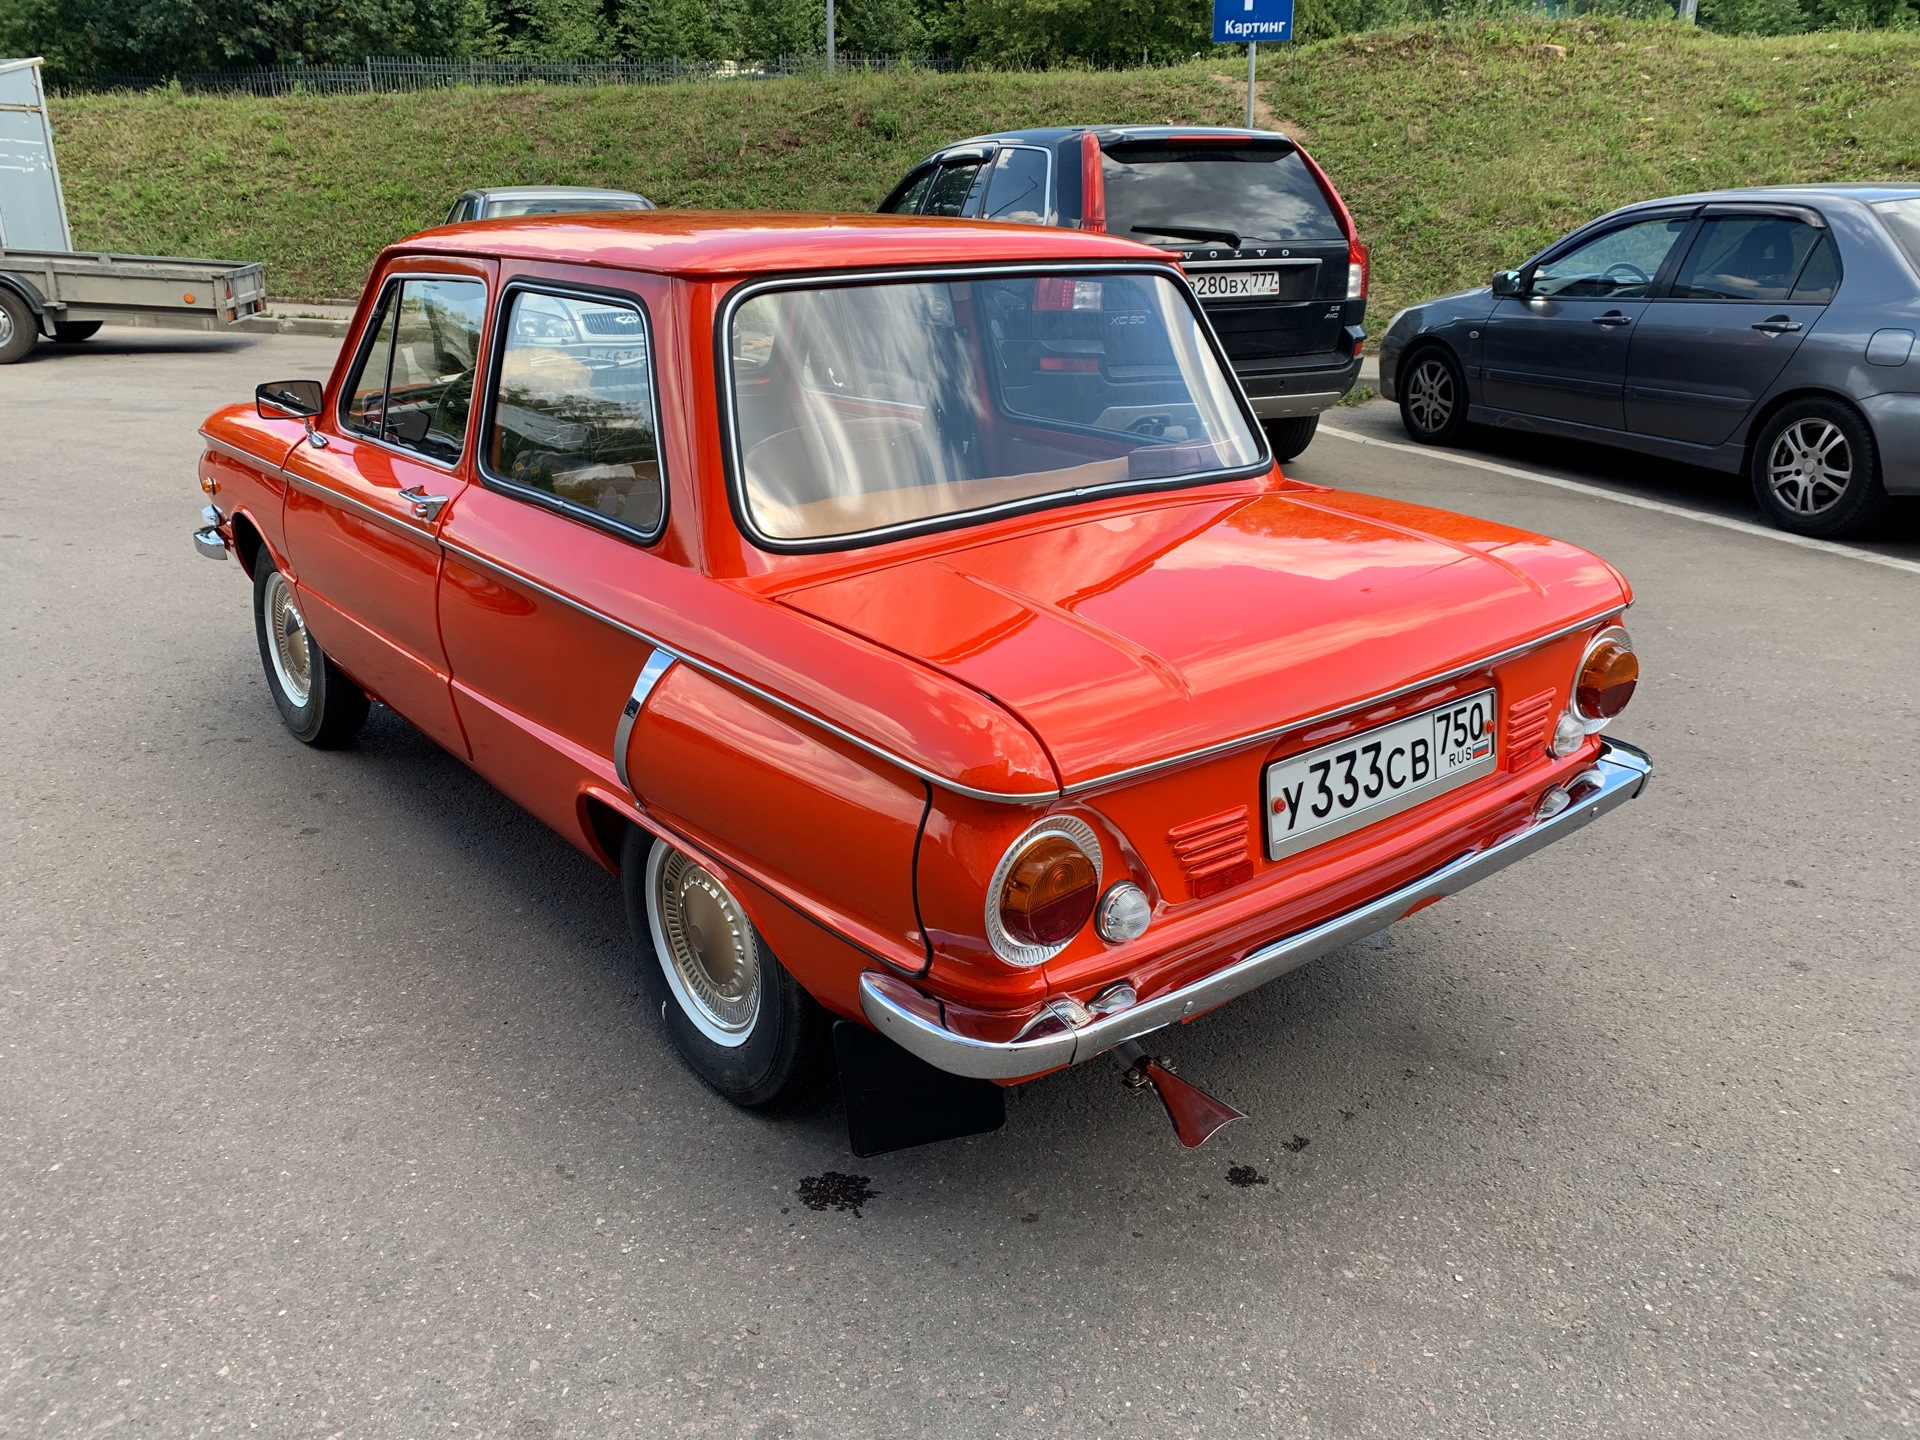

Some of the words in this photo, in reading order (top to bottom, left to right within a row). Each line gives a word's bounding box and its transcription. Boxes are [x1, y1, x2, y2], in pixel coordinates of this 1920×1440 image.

[1225, 20, 1286, 37] Картинг
[1183, 249, 1290, 260] VOLVO
[1251, 273, 1276, 287] 777
[1449, 747, 1472, 768] RUS
[1282, 738, 1430, 831] У333СВ
[1436, 702, 1484, 756] 750
